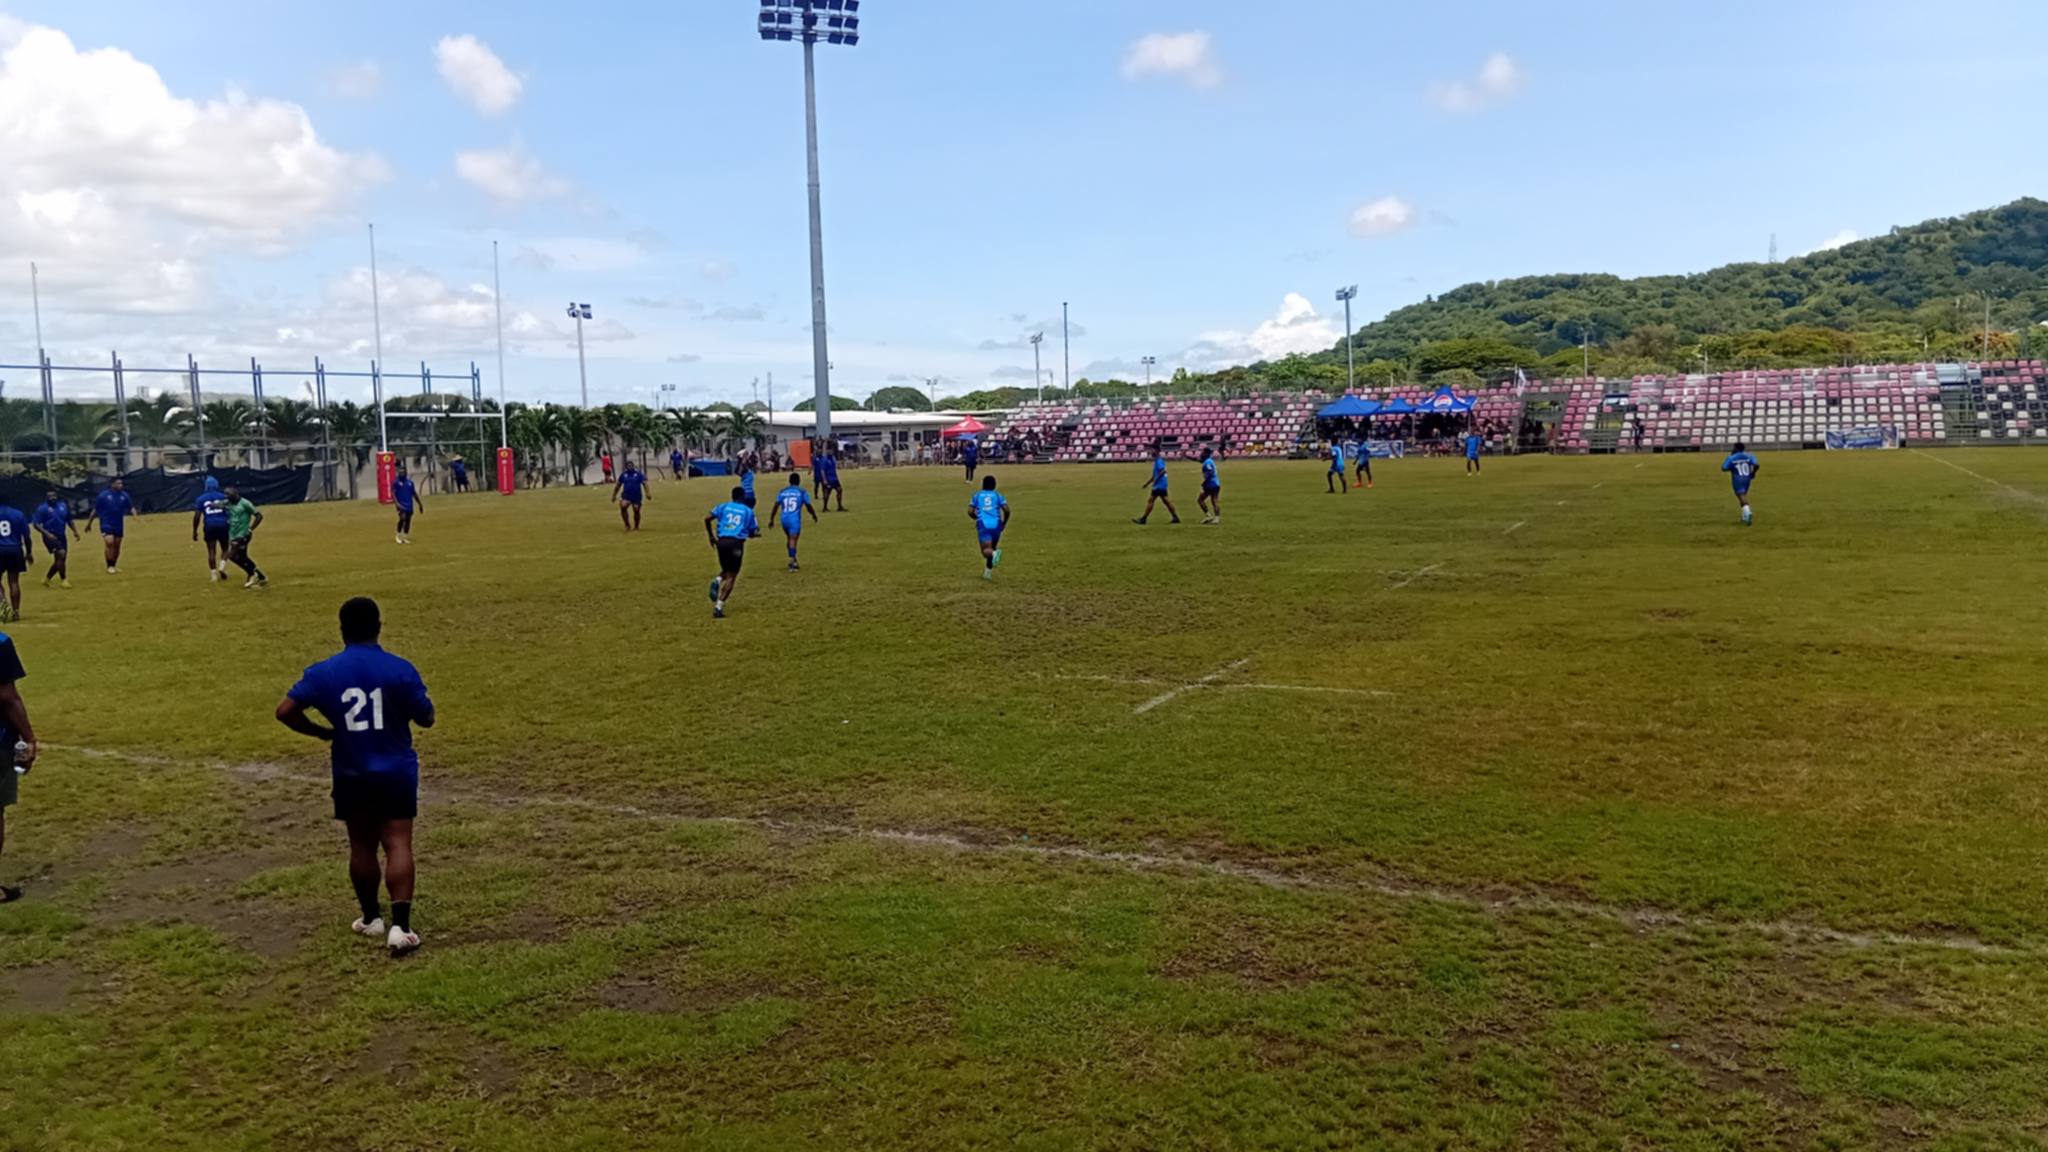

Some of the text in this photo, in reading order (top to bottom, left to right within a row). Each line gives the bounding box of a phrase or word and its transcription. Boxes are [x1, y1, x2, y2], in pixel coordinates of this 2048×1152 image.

[1735, 462, 1749, 476] 10
[783, 497, 797, 512] 15
[727, 513, 741, 525] 14
[341, 687, 383, 731] 21
